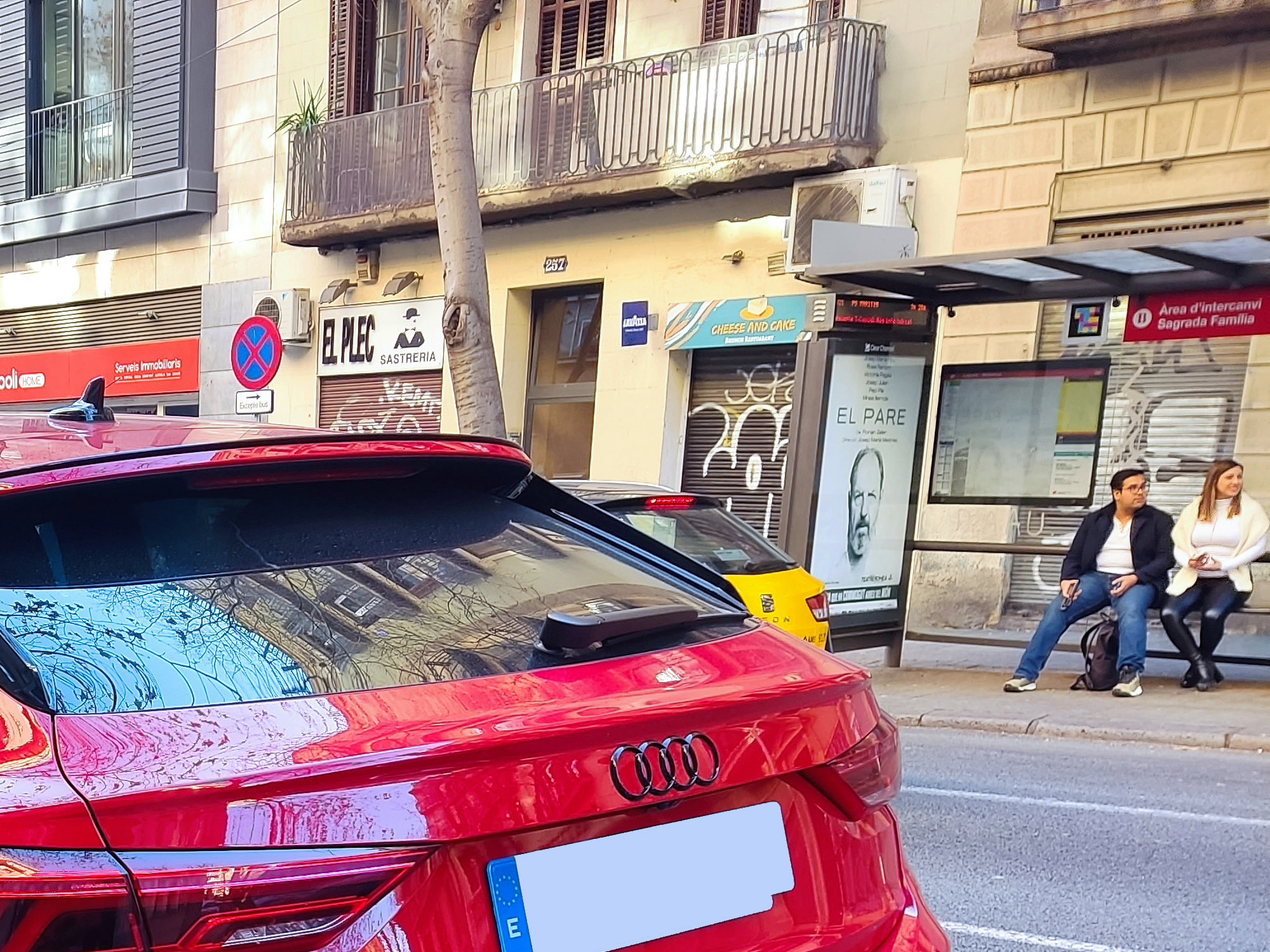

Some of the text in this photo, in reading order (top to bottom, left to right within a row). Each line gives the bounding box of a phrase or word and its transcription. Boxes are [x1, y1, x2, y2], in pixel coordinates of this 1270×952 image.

[545, 257, 566, 272] 257
[1159, 298, 1263, 316] Àrea d'intercanvi
[711, 319, 797, 335] CHEESE AND CAKE
[1157, 317, 1208, 332] Sagrada
[321, 313, 376, 365] EL PLEC
[380, 351, 437, 366] SASTRERIA
[115, 361, 140, 374] Serveis
[21, 376, 42, 387] HOME
[837, 407, 907, 426] EL PARE
[506, 917, 522, 939] E
